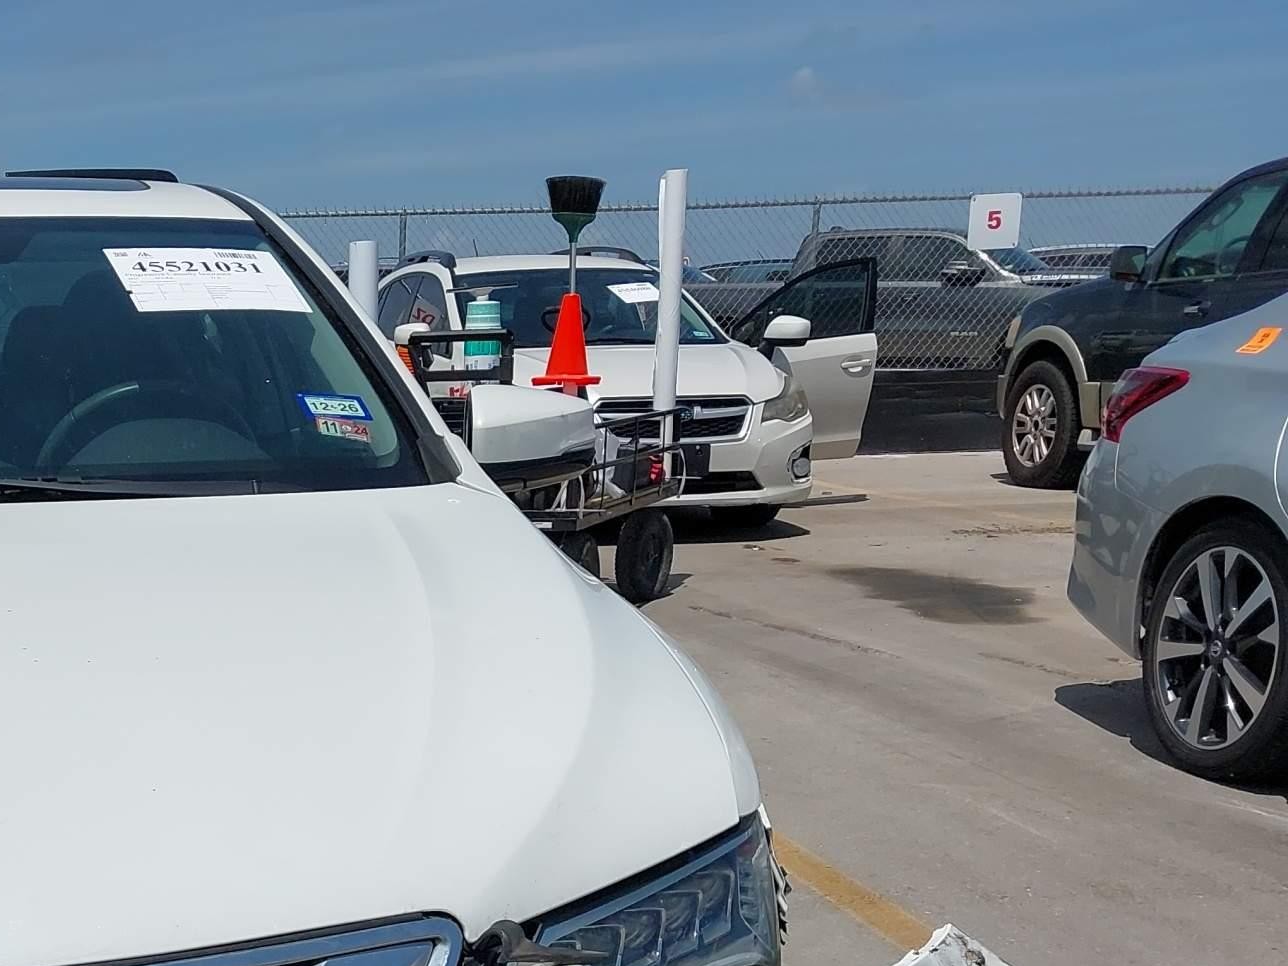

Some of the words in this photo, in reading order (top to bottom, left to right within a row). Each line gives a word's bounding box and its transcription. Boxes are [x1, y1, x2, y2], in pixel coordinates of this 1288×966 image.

[987, 210, 1002, 230] 5
[132, 261, 263, 274] 45521031
[322, 421, 338, 434] 11
